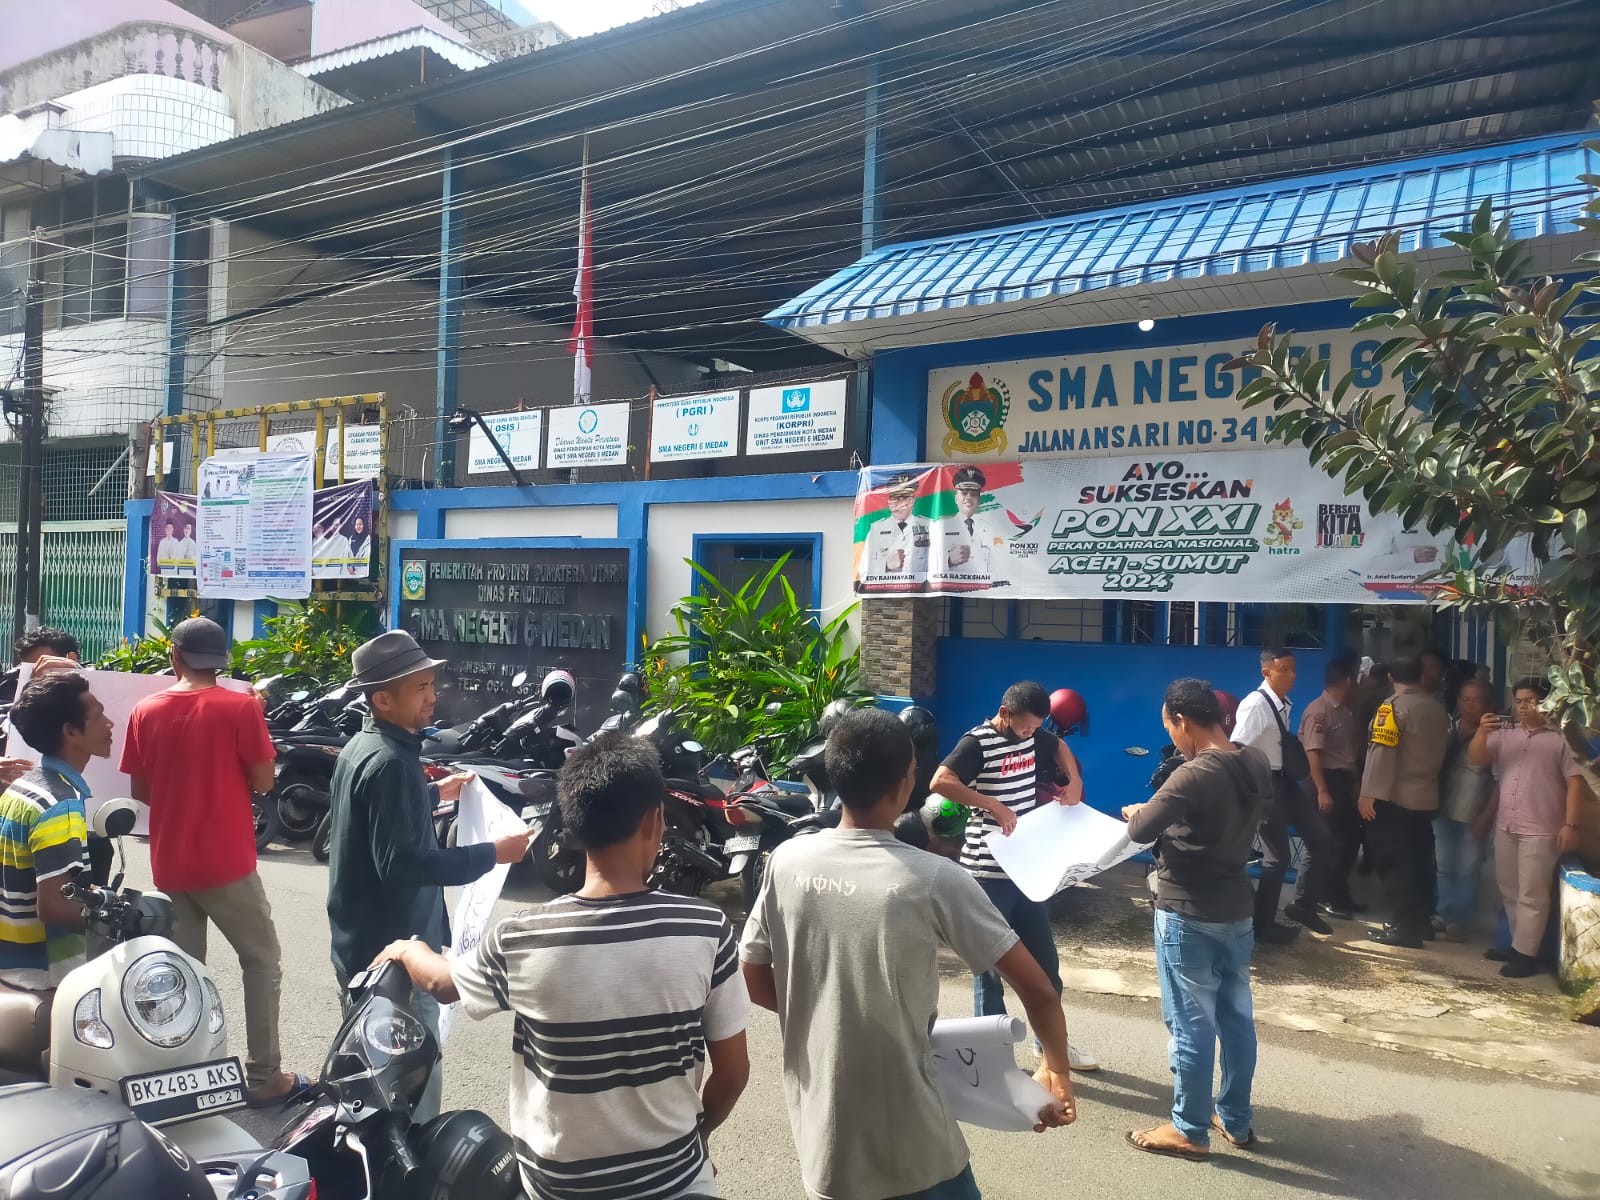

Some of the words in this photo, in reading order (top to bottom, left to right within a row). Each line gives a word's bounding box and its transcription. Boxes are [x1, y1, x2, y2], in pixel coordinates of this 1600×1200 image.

[1028, 364, 1119, 412] SMA
[776, 419, 814, 430] (KORPRI)
[658, 445, 672, 453] SMA
[673, 443, 698, 452] NEGERI
[704, 440, 729, 449] MEDAN
[755, 438, 770, 446] UNIT
[770, 437, 783, 446] SMA
[783, 435, 806, 445] NEGERI
[812, 433, 834, 442] MEDAN
[1018, 428, 1075, 453] JALAN
[1079, 421, 1170, 450] ANSARI
[1121, 461, 1209, 482] AYO...
[1078, 479, 1254, 505] SUKSESKAN
[1318, 503, 1361, 515] BERSATU
[1051, 507, 1164, 539] PON
[1158, 503, 1262, 536] XXI
[1318, 513, 1362, 535] KITA
[1048, 541, 1095, 554] PEKAN
[1096, 539, 1174, 553] OLAHRAGA
[1176, 537, 1256, 551] NASIONAL
[1268, 545, 1301, 556] hatra
[429, 563, 483, 580] PEMERINTAH
[488, 563, 529, 581] PROVINSI
[1048, 556, 1127, 574] ACEH
[1142, 554, 1250, 574] SUMUT
[1103, 573, 1175, 592] 2024
[478, 585, 505, 602] DINAS
[452, 609, 520, 645] NEGERI
[541, 613, 614, 650] MEDAN
[206, 1065, 238, 1088] AKS
[490, 1151, 514, 1176] YAMAHA
